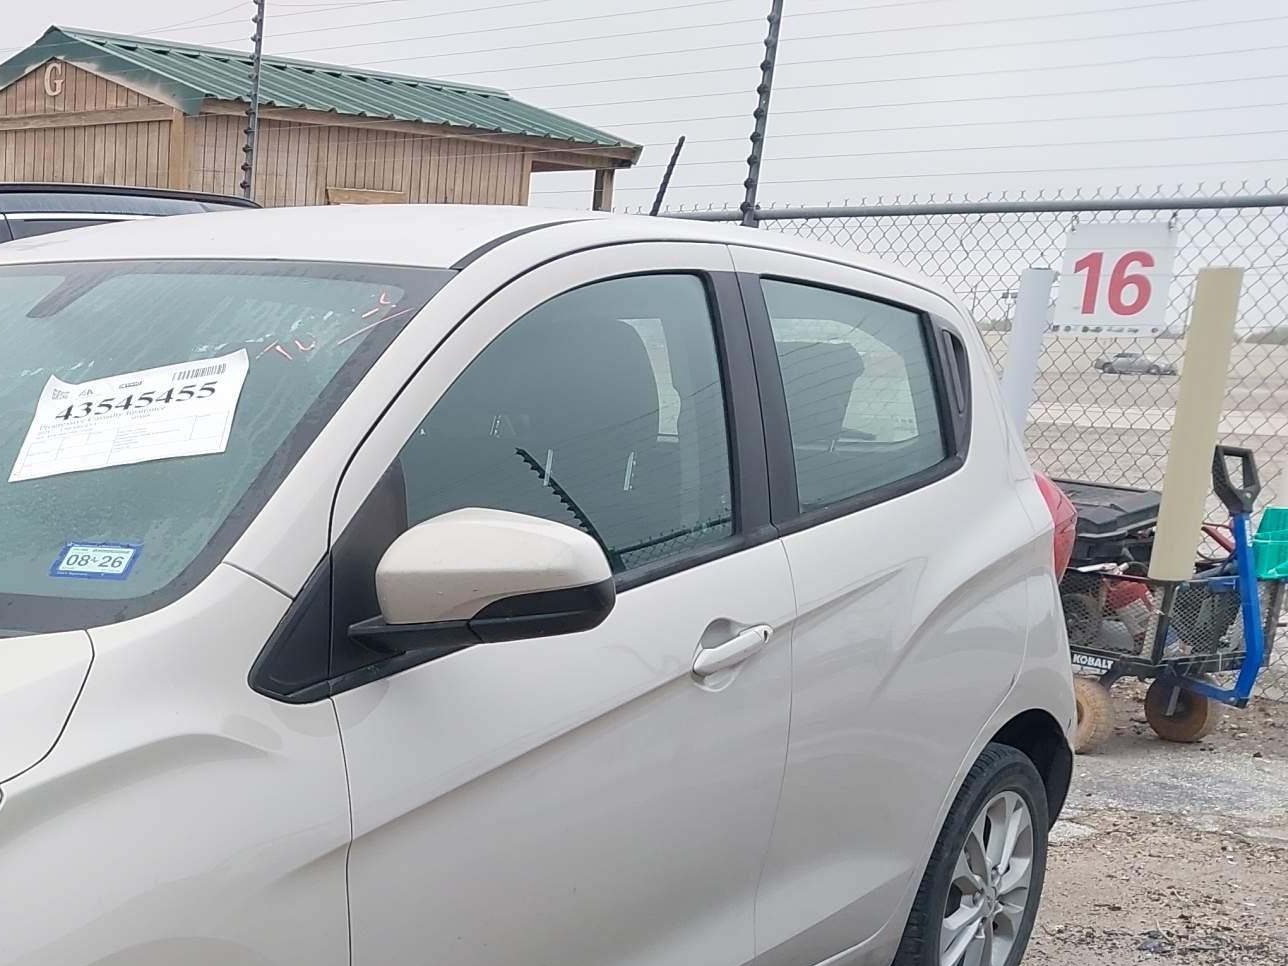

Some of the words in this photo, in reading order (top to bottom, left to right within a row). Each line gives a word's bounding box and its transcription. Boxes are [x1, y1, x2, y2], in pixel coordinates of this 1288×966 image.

[44, 63, 64, 96] G
[1074, 250, 1155, 316] 16
[55, 381, 218, 421] 43545455
[1073, 653, 1114, 669] KOBALT
